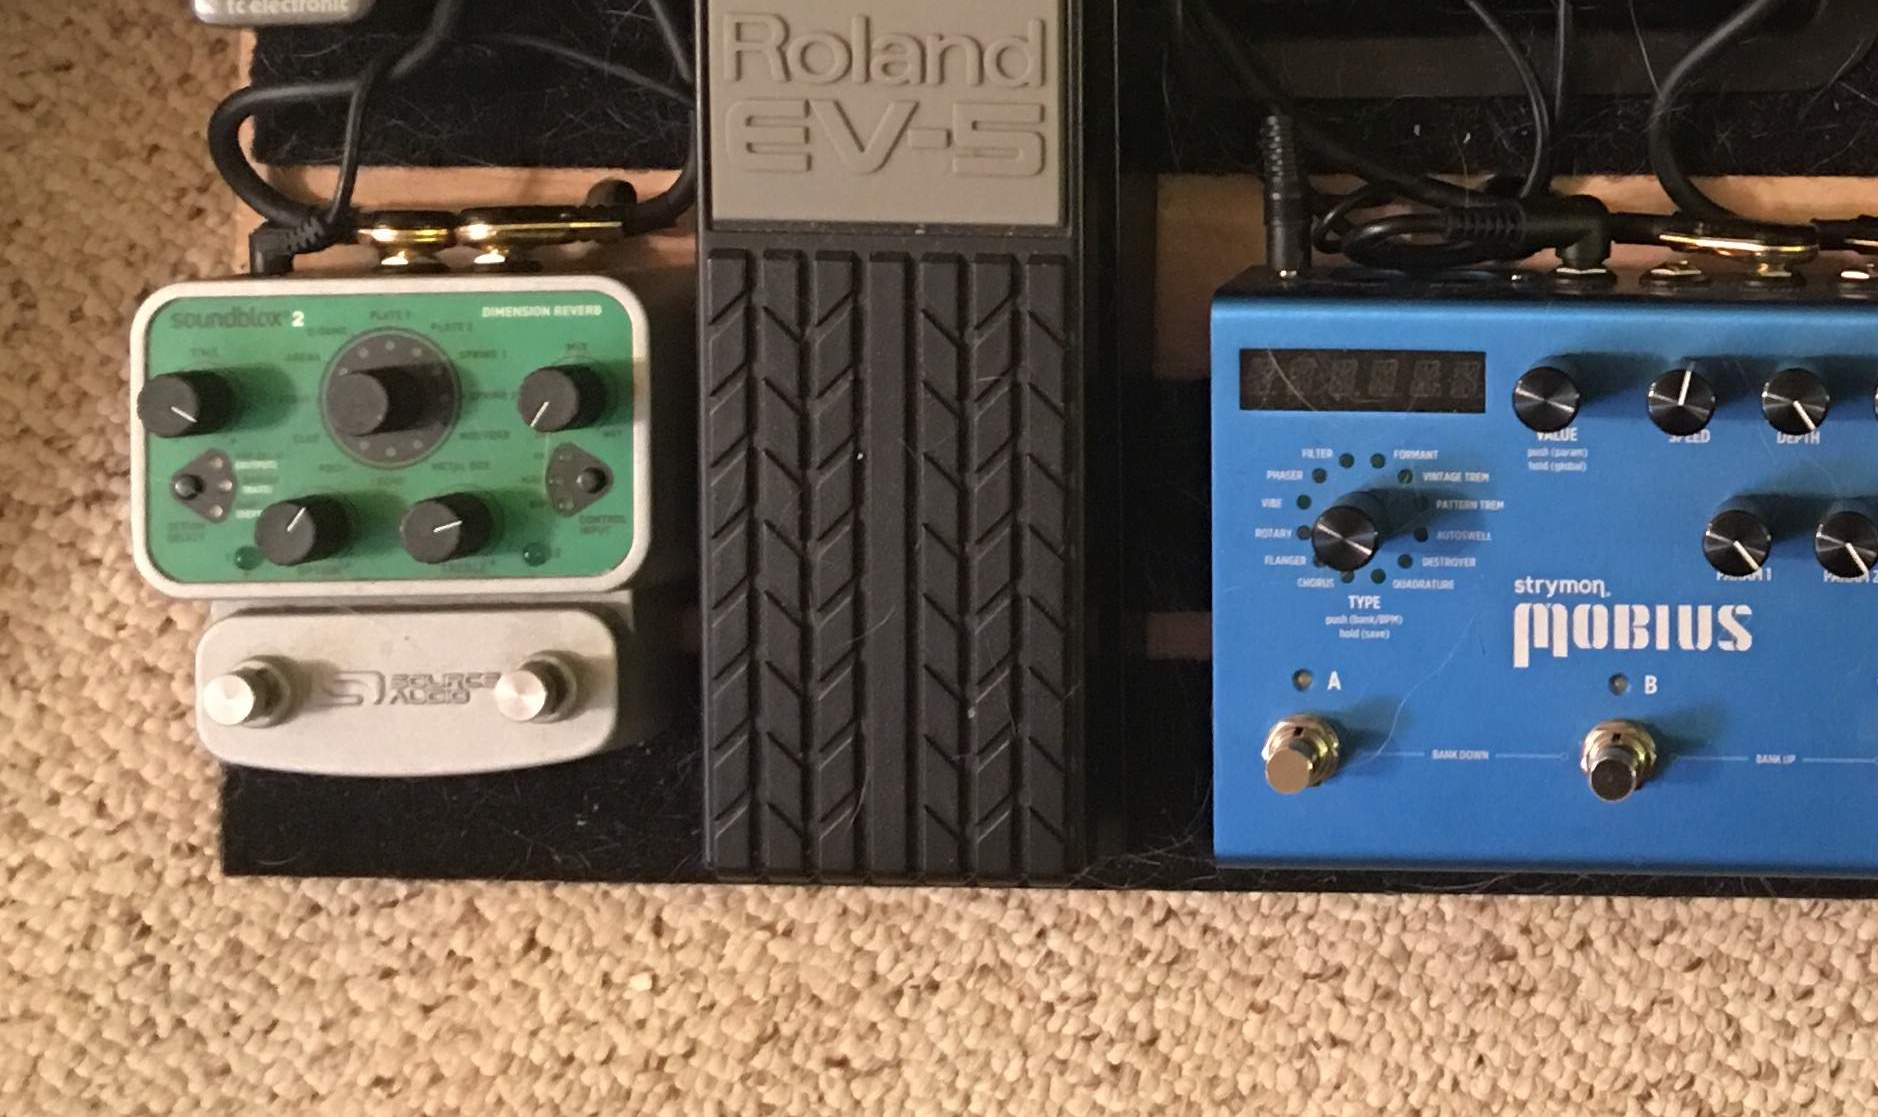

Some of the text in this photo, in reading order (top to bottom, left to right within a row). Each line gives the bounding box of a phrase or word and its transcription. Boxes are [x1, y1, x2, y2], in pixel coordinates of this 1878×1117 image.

[722, 11, 1046, 89] Roland
[725, 98, 1046, 177] EV-5
[170, 306, 304, 329] soundblox 2
[482, 305, 602, 317] DIMENSION REVERB
[1302, 449, 1333, 458] FILTER
[1394, 450, 1438, 460] FORMANT
[1267, 470, 1303, 480] PHASER
[1349, 596, 1380, 608] TYPE
[1327, 673, 1342, 691] A
[1643, 676, 1658, 694] B
